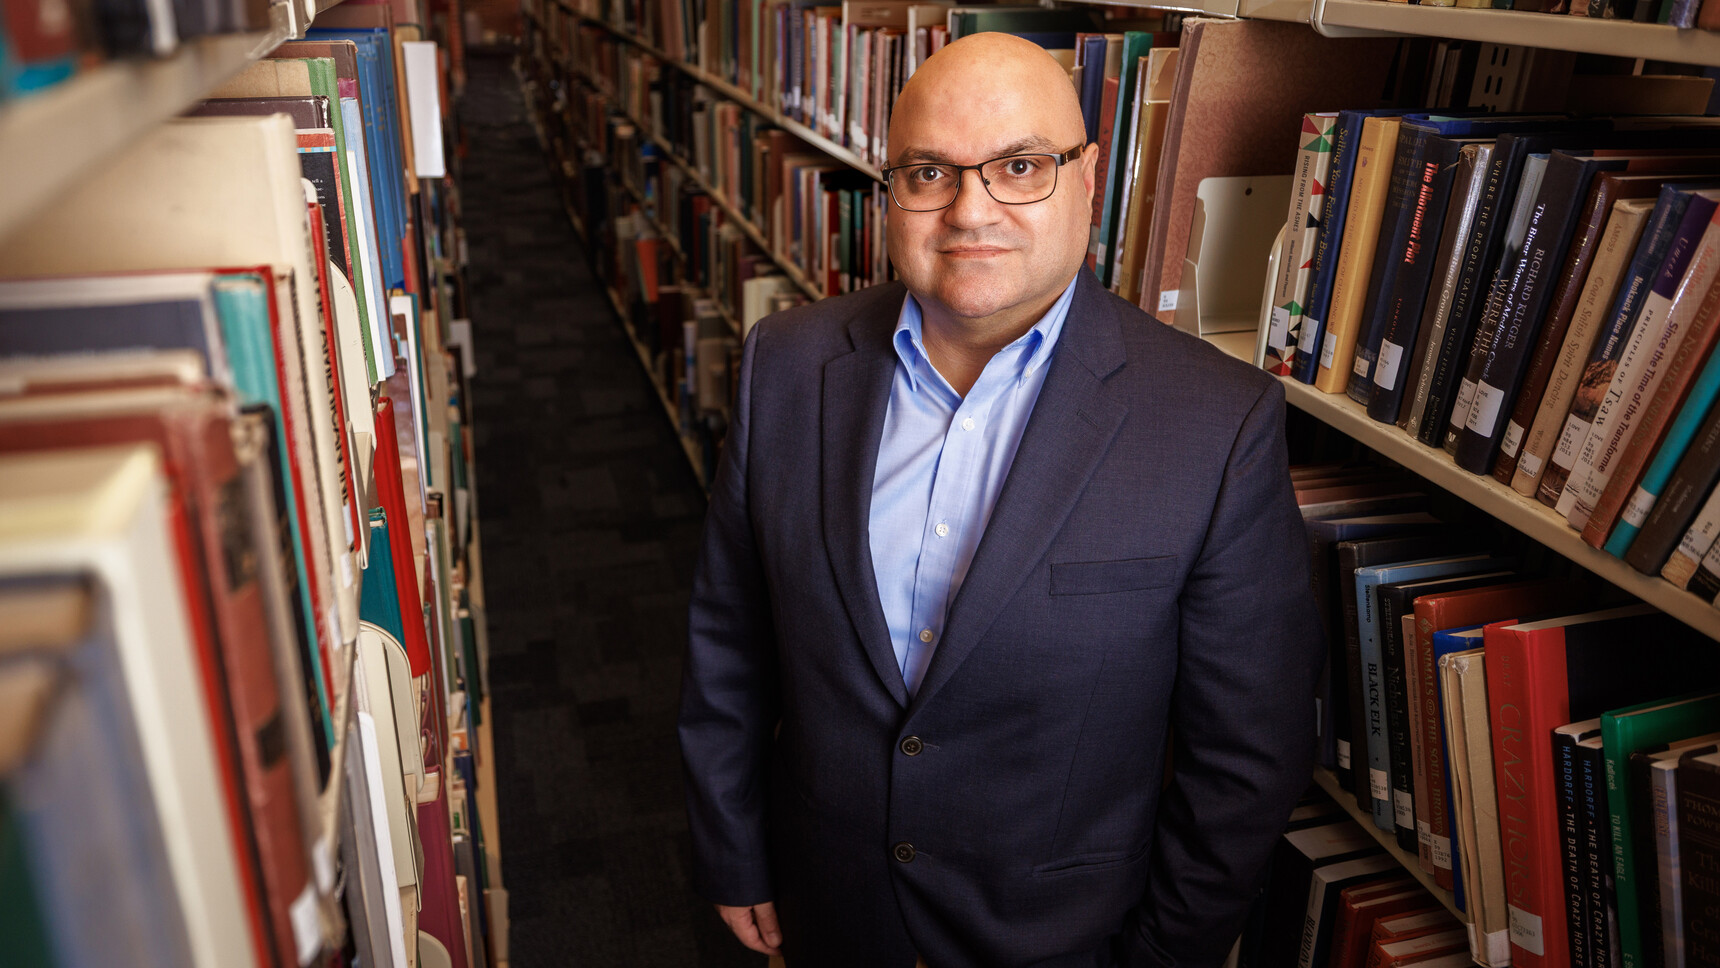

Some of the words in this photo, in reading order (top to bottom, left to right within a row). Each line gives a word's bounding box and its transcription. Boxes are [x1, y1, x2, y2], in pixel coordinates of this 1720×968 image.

[1301, 155, 1310, 178] RISING
[1328, 168, 1340, 192] Your
[1421, 161, 1438, 184] The
[1485, 159, 1502, 200] WHERE
[1298, 178, 1306, 197] FROM
[1292, 211, 1301, 232] ASHES
[1320, 195, 1336, 238] Father's
[1407, 184, 1434, 240] Allotment
[1478, 205, 1490, 227] THE
[1531, 202, 1545, 225] The
[1403, 240, 1421, 265] Plot
[1466, 231, 1483, 272] PEOPLE
[1521, 226, 1537, 256] Bitter
[1605, 222, 1622, 253] AMOSS
[1314, 240, 1327, 271] Bones
[1444, 256, 1459, 288] Burial
[1509, 257, 1527, 292] Waters
[1518, 247, 1547, 301] RICHARD
[1453, 277, 1471, 318] GATHER
[1478, 266, 1502, 323] SALMON
[1486, 277, 1510, 326] WHERE
[1505, 292, 1515, 305] of
[1585, 275, 1605, 306] Coast
[1619, 275, 1644, 313] Nooksack
[1433, 289, 1451, 328] Ground
[1573, 307, 1593, 339] Salish
[1611, 312, 1627, 334] Place
[1691, 305, 1712, 334] THE
[1490, 304, 1511, 349] Medicine
[1502, 302, 1528, 350] KLUGER
[1623, 309, 1654, 368] PRINCIPLES
[1657, 320, 1679, 350] Since
[1425, 340, 1436, 364] Jerome
[1469, 328, 1483, 356] RUN
[1477, 329, 1494, 356] THE
[1560, 339, 1580, 369] Spirit
[1600, 334, 1618, 360] Names
[1480, 349, 1496, 379] Creek
[1648, 350, 1664, 368] the
[1659, 335, 1697, 394] NOOTKA
[1545, 368, 1570, 410] Dancing
[1616, 371, 1626, 384] OF
[1636, 366, 1656, 393] Time
[1594, 386, 1622, 429] Tsaw
[1622, 404, 1638, 422] the
[1630, 392, 1644, 406] of
[1568, 422, 1581, 432] LOVE
[1596, 420, 1629, 473] Transforme
[1421, 637, 1434, 695] ANIMALS
[1367, 662, 1378, 706] BLACK
[1386, 664, 1403, 726] Nicholas
[1370, 709, 1380, 736] ELK
[1427, 718, 1437, 744] THE
[1391, 729, 1406, 768] Black
[1429, 748, 1440, 779] SOUL
[1498, 702, 1528, 809] CRAZY
[1560, 746, 1574, 802] HARDORFF
[1581, 760, 1596, 818] HARDORFF
[1605, 758, 1617, 790] Kadlecek
[1431, 786, 1444, 836] BROWN
[1565, 812, 1575, 833] THE
[1611, 814, 1620, 824] TO
[1587, 828, 1597, 848] THE
[1612, 825, 1622, 841] KILL
[1567, 837, 1578, 871] DEATH
[1614, 843, 1623, 855] AN
[1570, 876, 1578, 890] OF
[1588, 852, 1600, 888] DEATH
[1615, 856, 1625, 881] EAGLE
[1571, 893, 1583, 927] CRAZY
[1591, 892, 1601, 907] OF
[1592, 910, 1605, 944] CRAZY
[1573, 931, 1585, 966] HORSE
